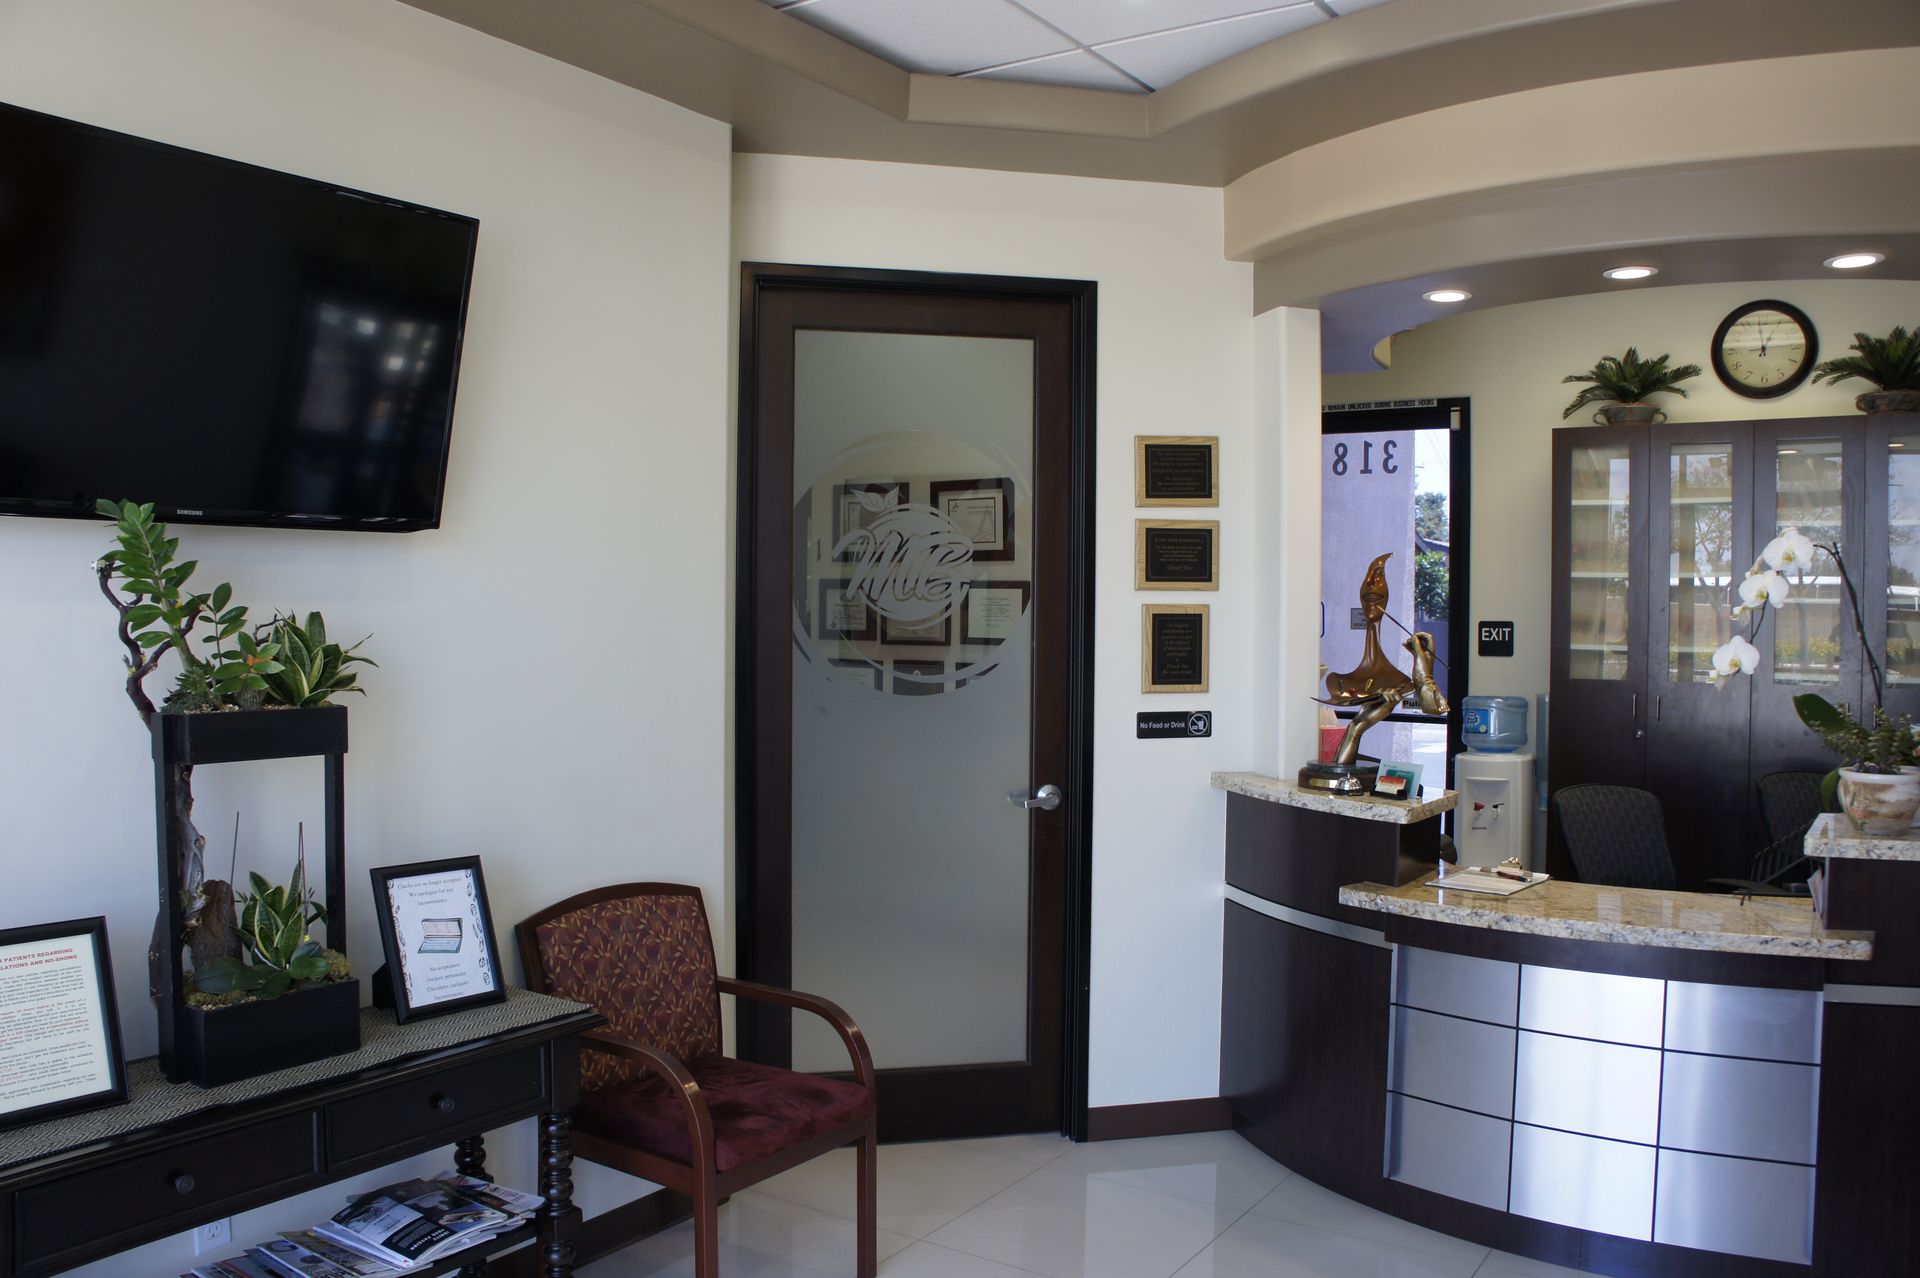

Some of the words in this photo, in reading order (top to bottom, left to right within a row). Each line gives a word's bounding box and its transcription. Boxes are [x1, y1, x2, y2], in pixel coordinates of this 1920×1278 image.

[1732, 361, 1742, 372] 8
[1744, 370, 1754, 381] 7
[1760, 372, 1769, 385] 6
[1777, 368, 1785, 379] 5
[1394, 400, 1416, 408] BUSINESS
[1418, 399, 1435, 407] HOURS
[1481, 627, 1511, 641] EXIT
[4, 953, 36, 963] PATIENTS
[37, 948, 73, 958] REGARDING
[30, 959, 43, 967] AND
[44, 954, 78, 964] NO-SHOWS
